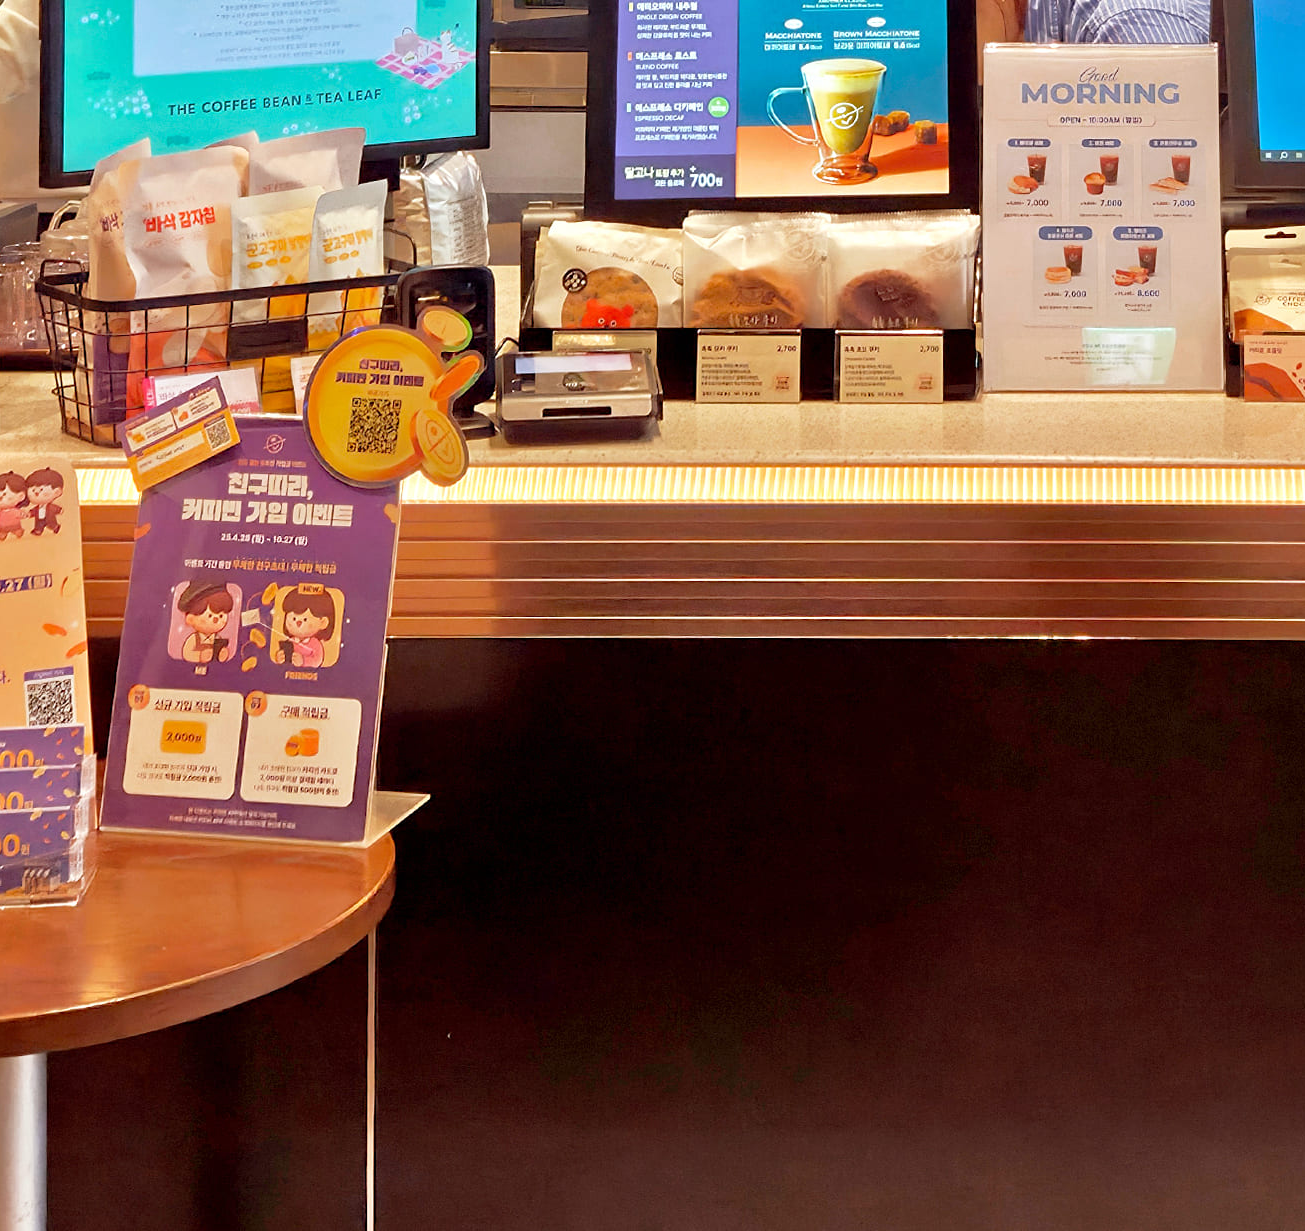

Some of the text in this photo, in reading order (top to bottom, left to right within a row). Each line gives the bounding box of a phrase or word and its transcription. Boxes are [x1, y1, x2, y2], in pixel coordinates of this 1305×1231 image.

[1079, 66, 1119, 83] Good
[168, 101, 196, 116] THE
[202, 97, 257, 114] COFFEE
[263, 95, 301, 108] BEAN
[317, 91, 343, 105] TEA
[348, 89, 381, 103] LEAF
[1021, 83, 1180, 104] MORNING
[1027, 199, 1049, 207] 7,000
[1100, 199, 1122, 207] 7,000
[179, 207, 216, 229] 감자칩
[228, 472, 313, 500] 친구따라,
[182, 499, 353, 527] 커피빈 가입 이벤트
